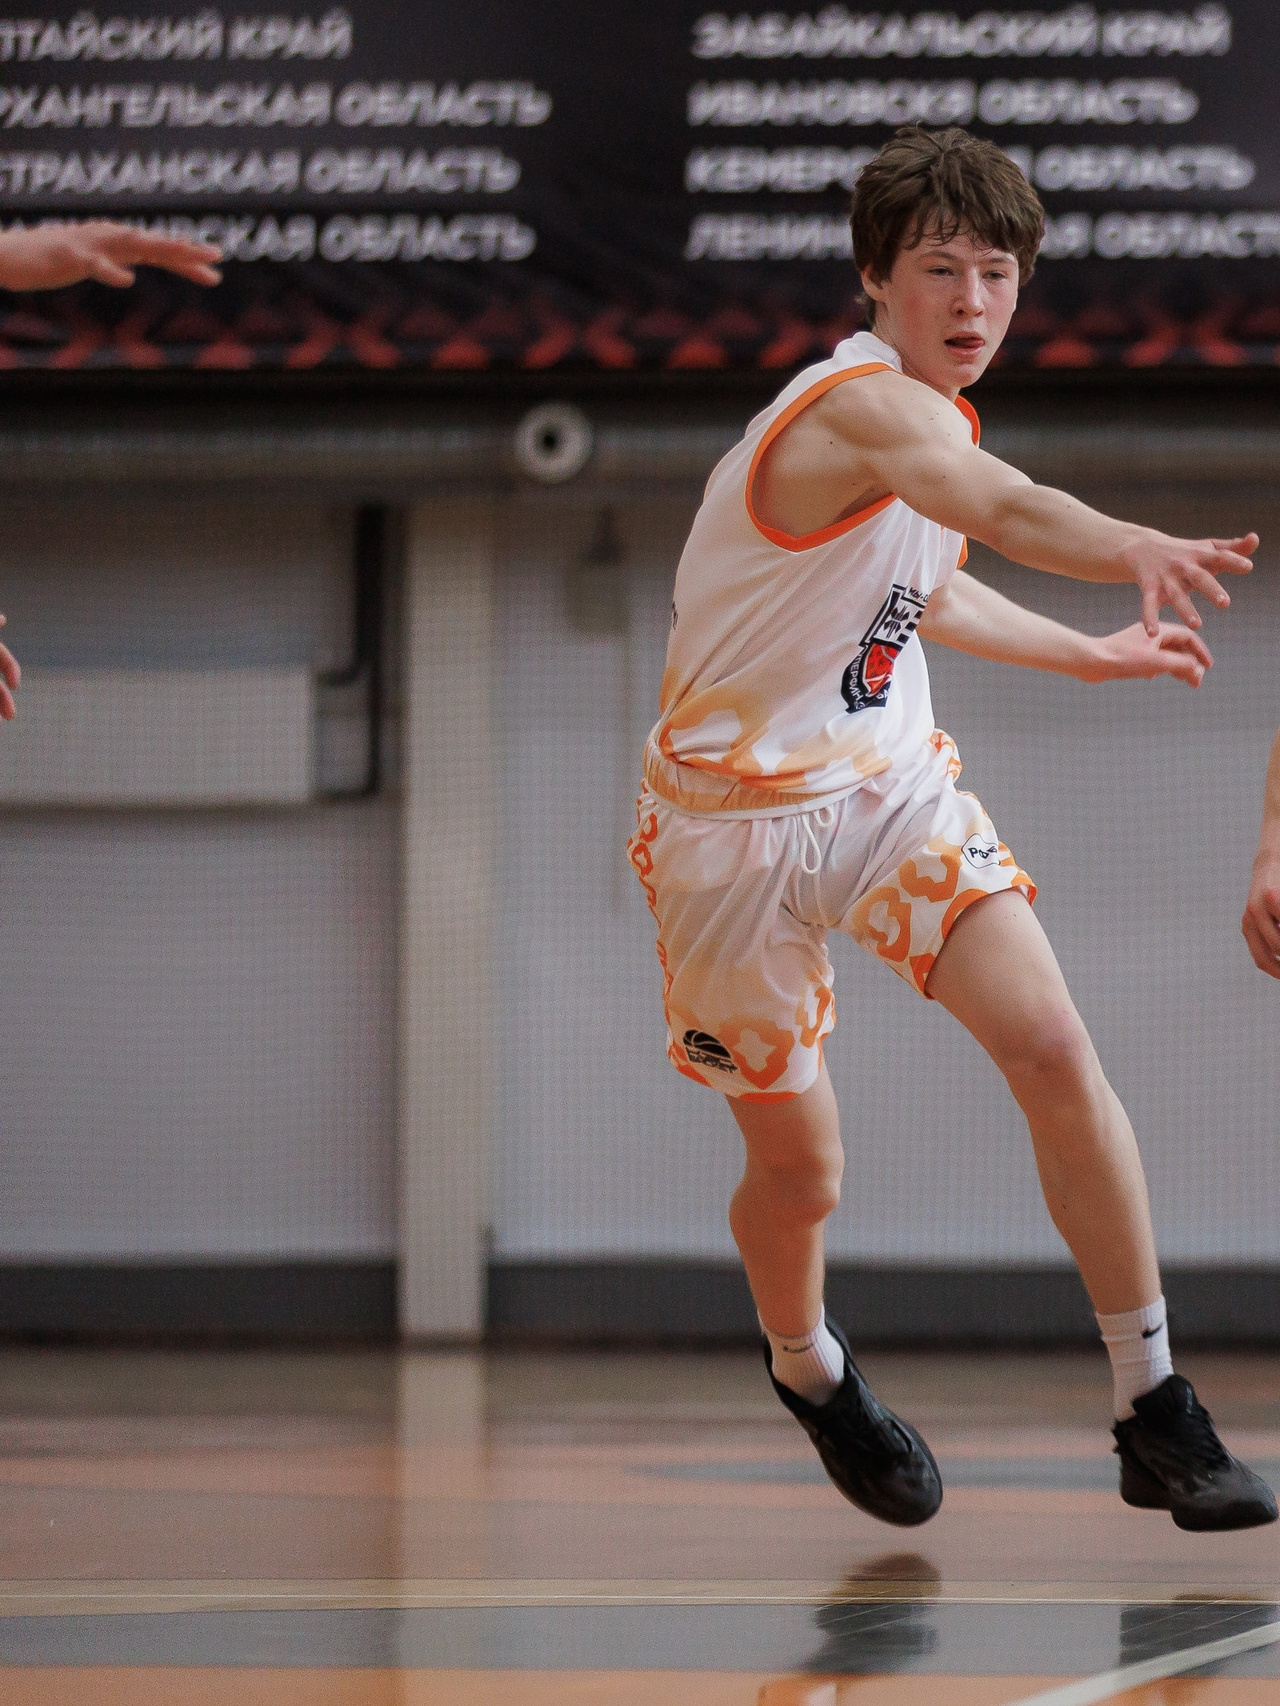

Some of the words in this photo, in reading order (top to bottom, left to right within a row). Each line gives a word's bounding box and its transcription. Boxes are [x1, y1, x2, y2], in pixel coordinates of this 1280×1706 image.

[228, 11, 353, 59] КРАЙ
[693, 8, 1098, 58] ЗАБАЙКАЛЬСКИЙ
[1103, 6, 1232, 56] КРАЙ
[336, 82, 551, 126] ОБЛАСТЬ
[979, 79, 1198, 123] ОБЛАСТЬ
[304, 148, 519, 193] ОБЛАСТЬ
[1035, 145, 1256, 190] ОБЛАСТЬ
[320, 216, 536, 260] ОБЛАСТЬ
